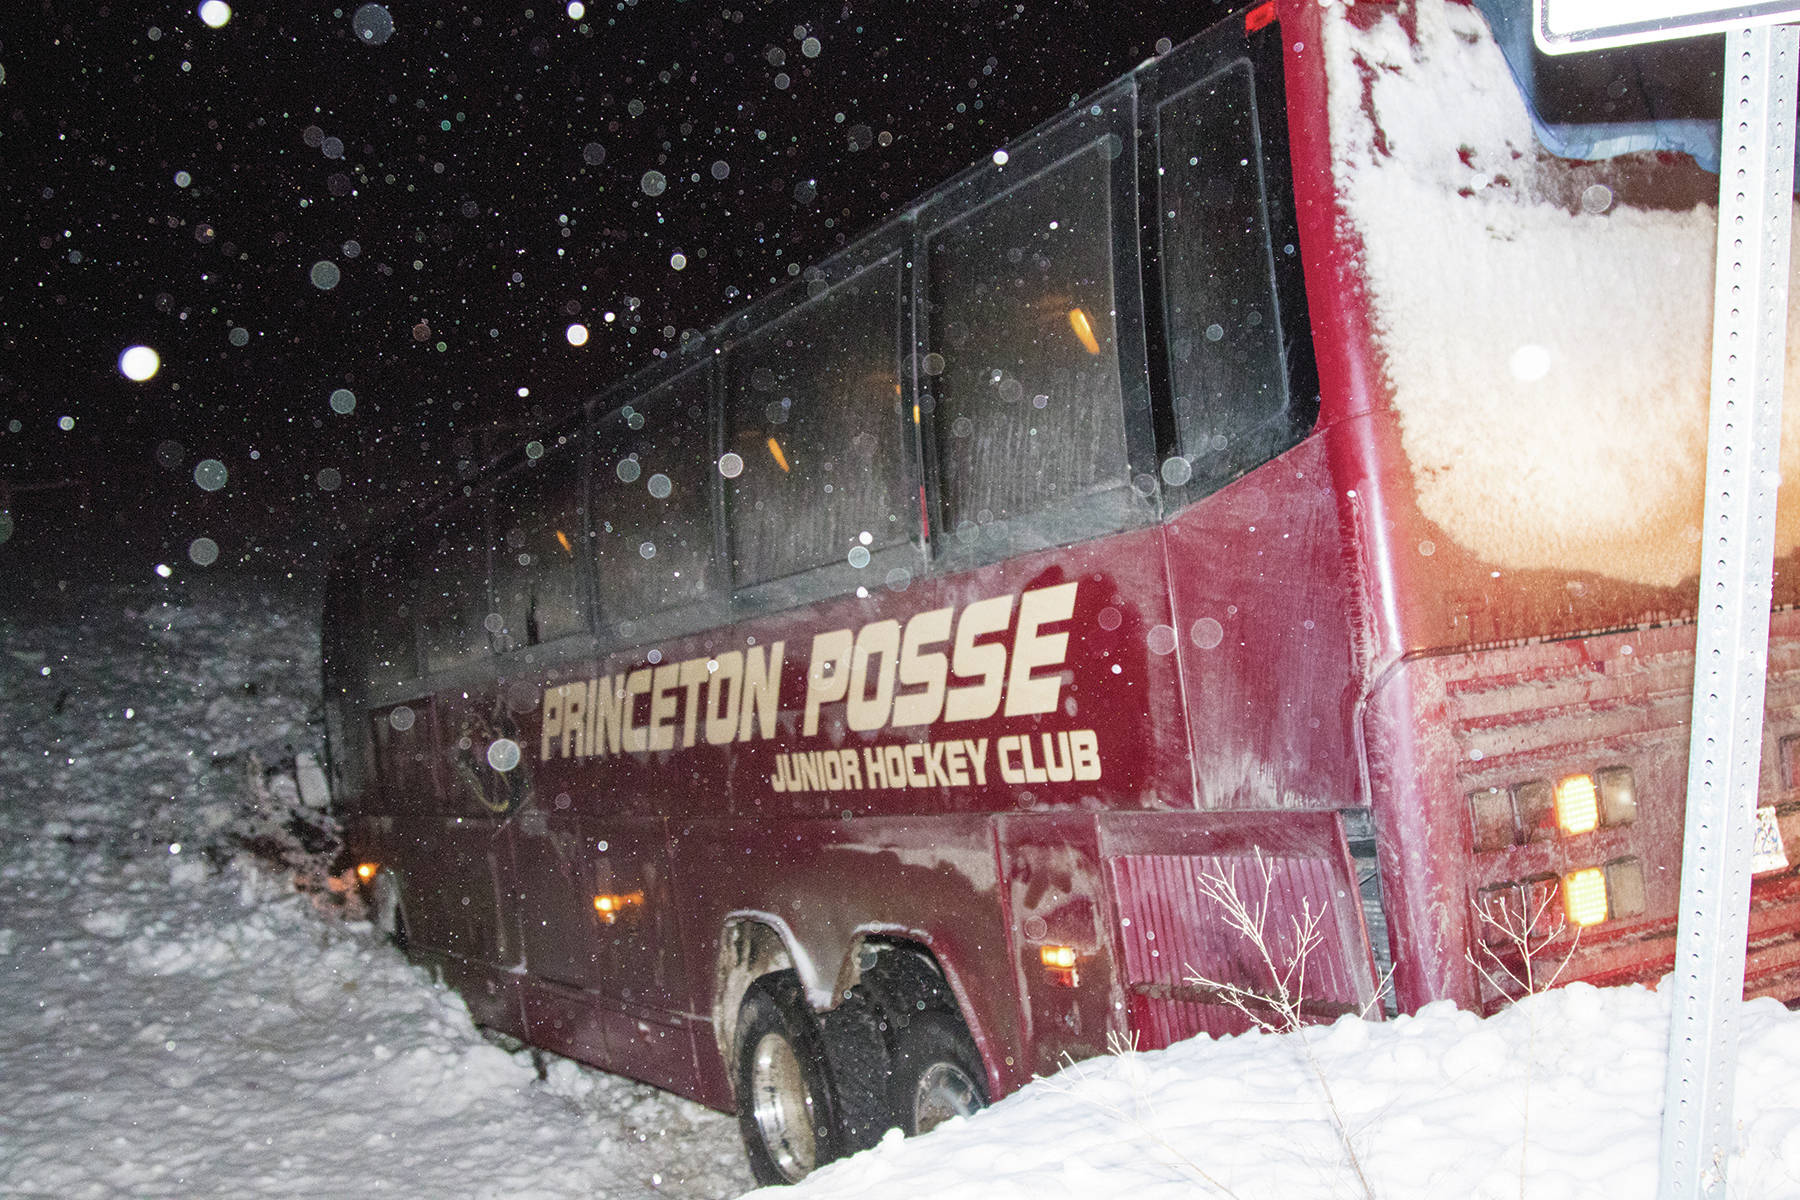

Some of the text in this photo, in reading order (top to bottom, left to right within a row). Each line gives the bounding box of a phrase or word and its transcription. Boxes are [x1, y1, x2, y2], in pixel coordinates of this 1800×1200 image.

[541, 581, 1079, 760] PRINCETON POSSE
[771, 729, 1101, 793] JUNIOR HOCKEY CLUB
